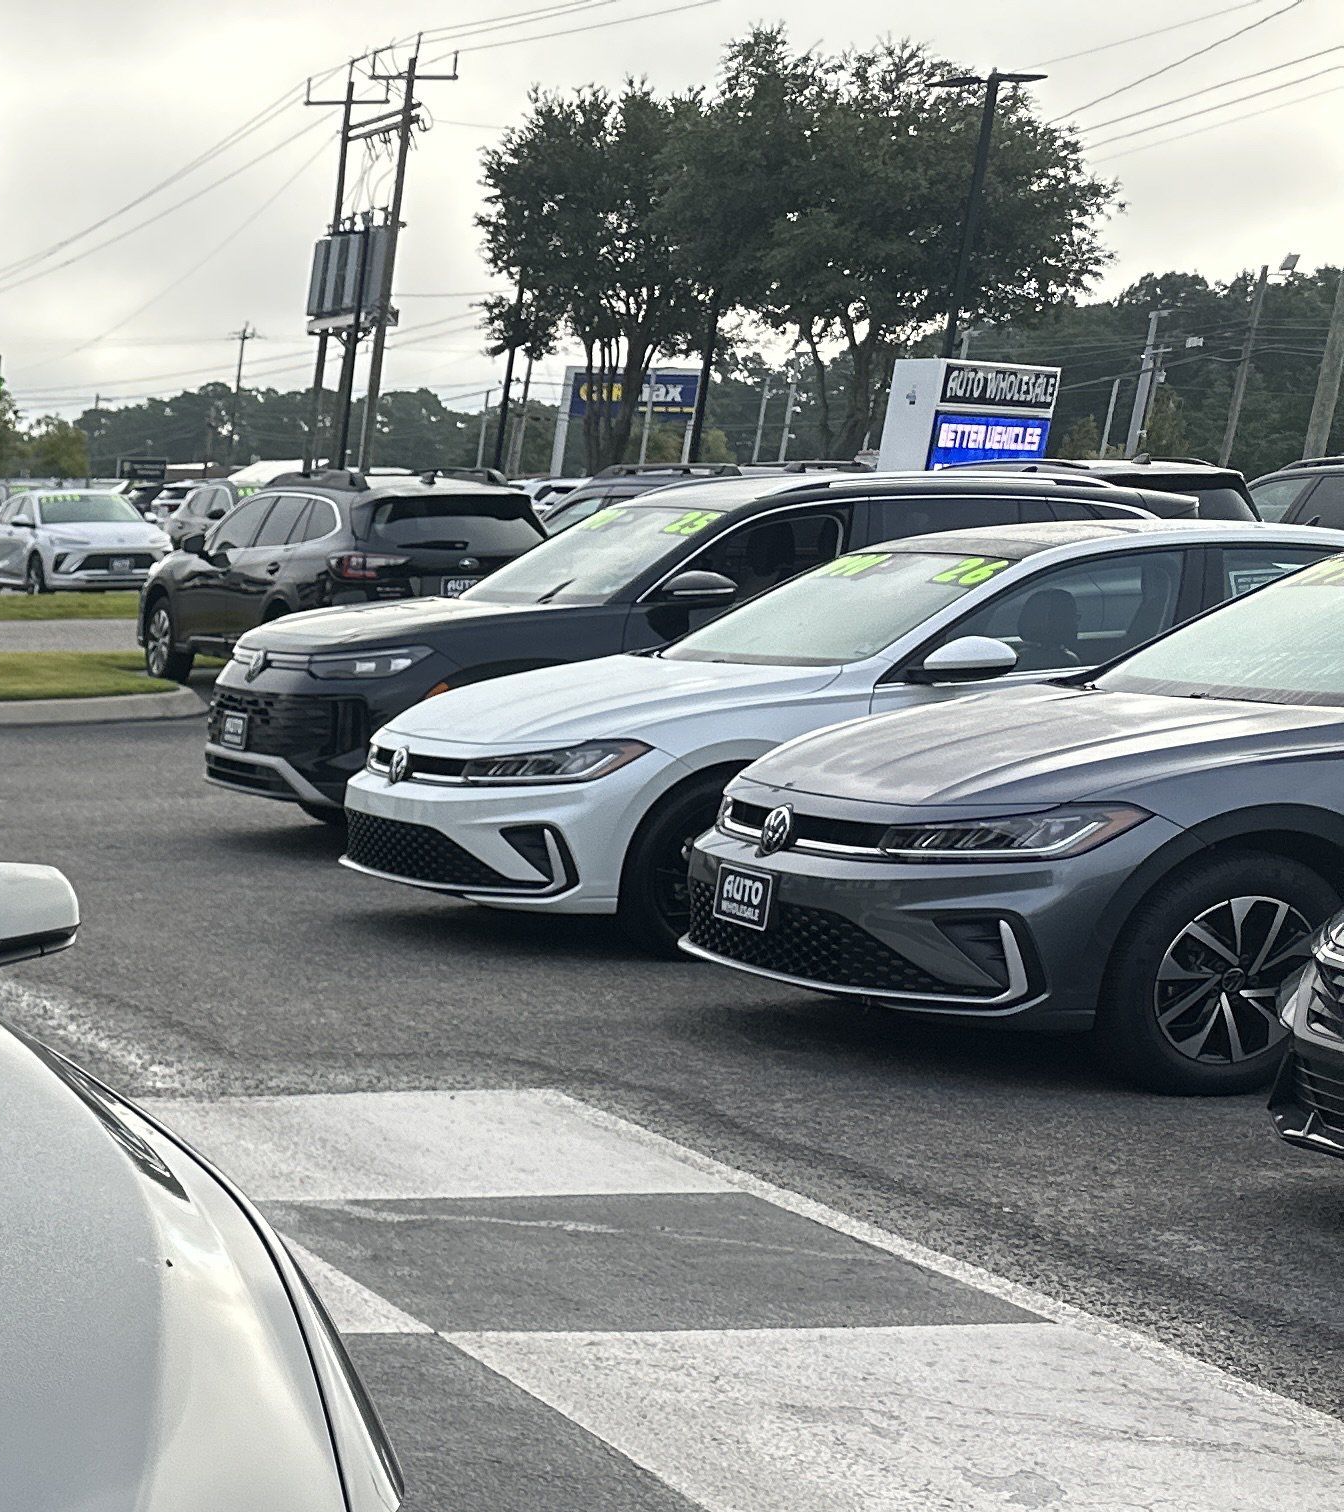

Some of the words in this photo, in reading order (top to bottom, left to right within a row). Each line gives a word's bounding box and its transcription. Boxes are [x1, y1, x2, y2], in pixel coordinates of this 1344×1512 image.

[946, 370, 985, 400] AUTO
[986, 373, 1056, 404] WHOLESALE
[938, 423, 986, 449] BETTER
[985, 426, 1042, 451] VEHICLES
[931, 557, 1009, 585] 26
[447, 580, 478, 592] AUT
[723, 875, 763, 905] AUTO
